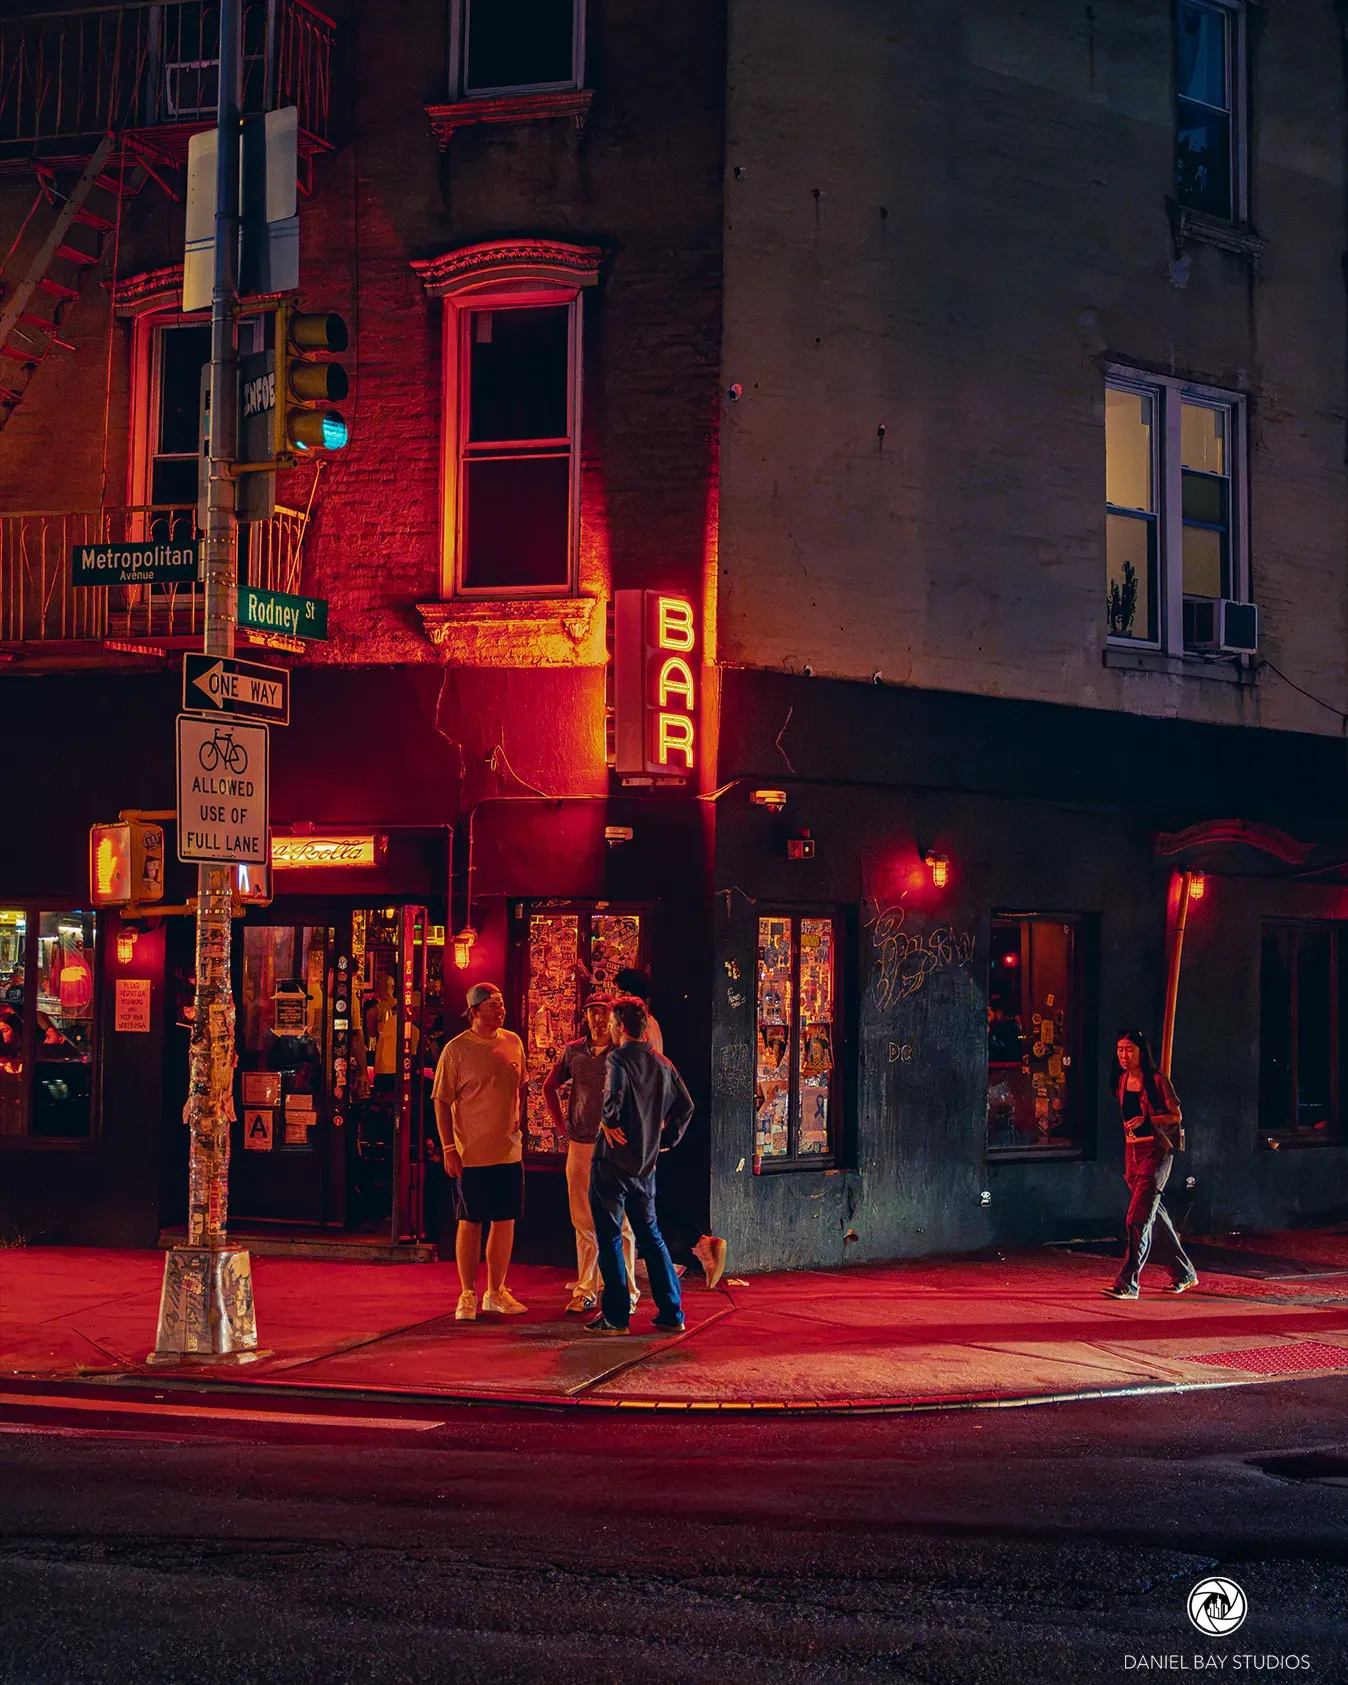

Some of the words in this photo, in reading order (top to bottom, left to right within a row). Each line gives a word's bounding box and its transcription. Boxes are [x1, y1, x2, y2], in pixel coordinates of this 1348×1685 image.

[81, 547, 193, 572] Metropolitan
[119, 570, 154, 581] Avenue
[248, 594, 299, 635] Rodney
[305, 601, 316, 619] St
[208, 673, 239, 697] ONE
[250, 680, 277, 705] WAY
[659, 596, 695, 768] BAR
[192, 776, 254, 797] ALLOWED
[200, 805, 225, 822] USE
[231, 808, 248, 824] OF
[187, 832, 220, 850] FULL
[226, 835, 259, 853] LANE
[249, 1113, 268, 1139] A
